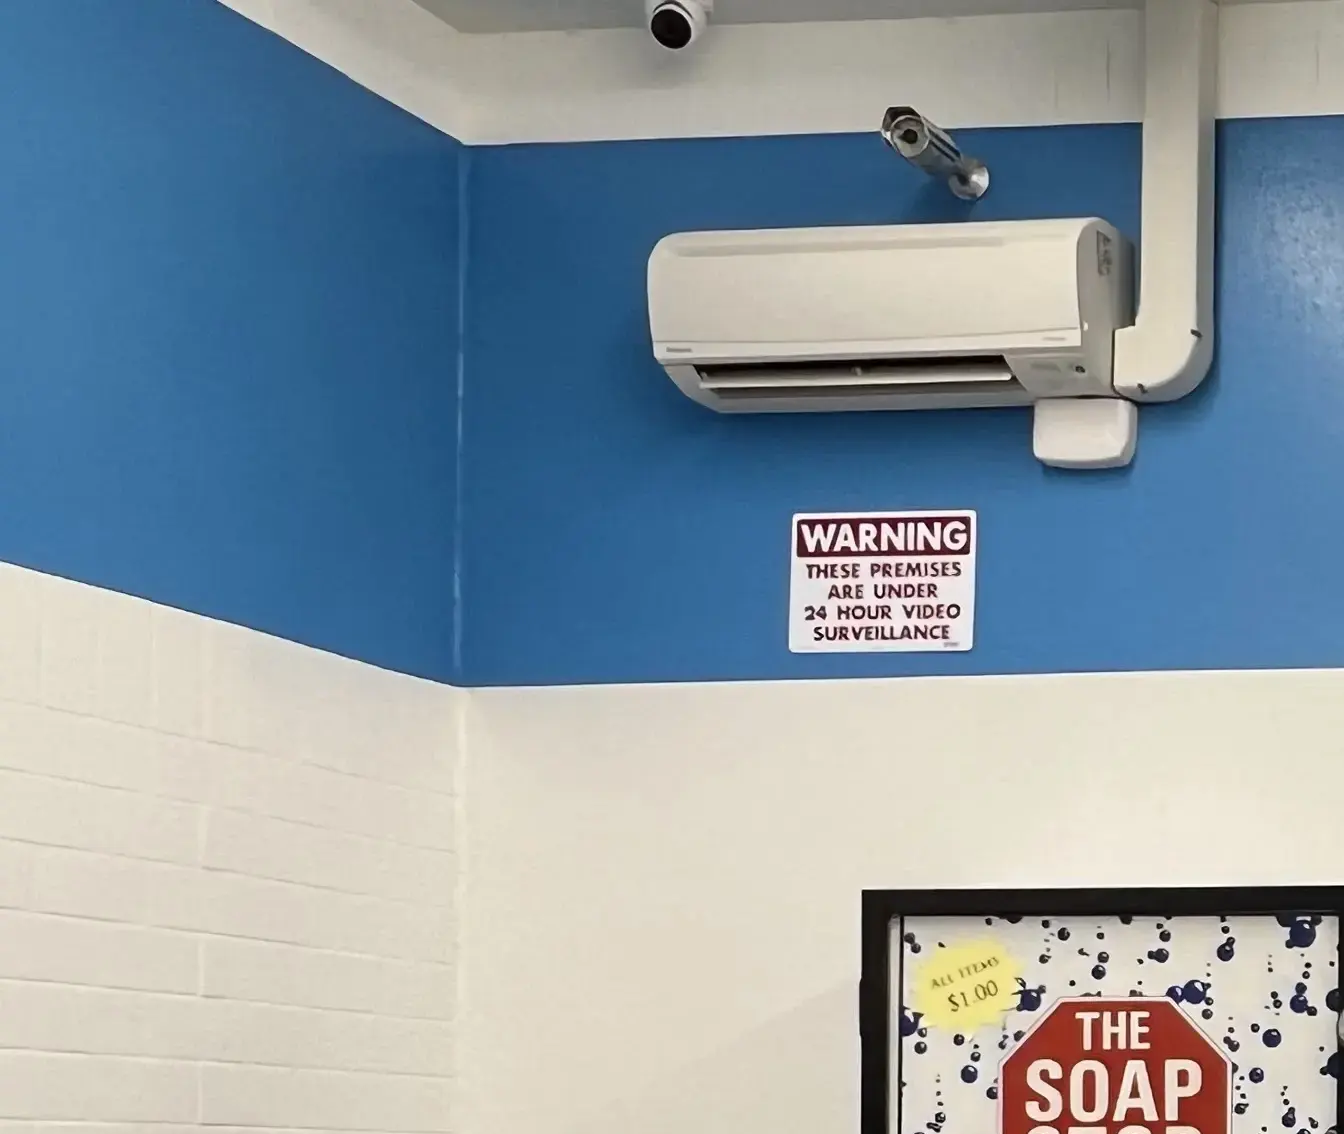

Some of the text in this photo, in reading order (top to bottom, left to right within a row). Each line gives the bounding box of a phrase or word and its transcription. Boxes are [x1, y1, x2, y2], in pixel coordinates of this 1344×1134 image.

[800, 520, 968, 554] WARNING
[805, 561, 962, 580] THESE PREMISES
[827, 583, 938, 600] ARE UNDER
[804, 603, 962, 621] 24 HOUR VIDEO
[813, 624, 951, 642] SURVEILLANCE
[947, 979, 999, 1013] $1.00
[1074, 1010, 1151, 1051] THE
[1024, 1058, 1203, 1123] SOAP
